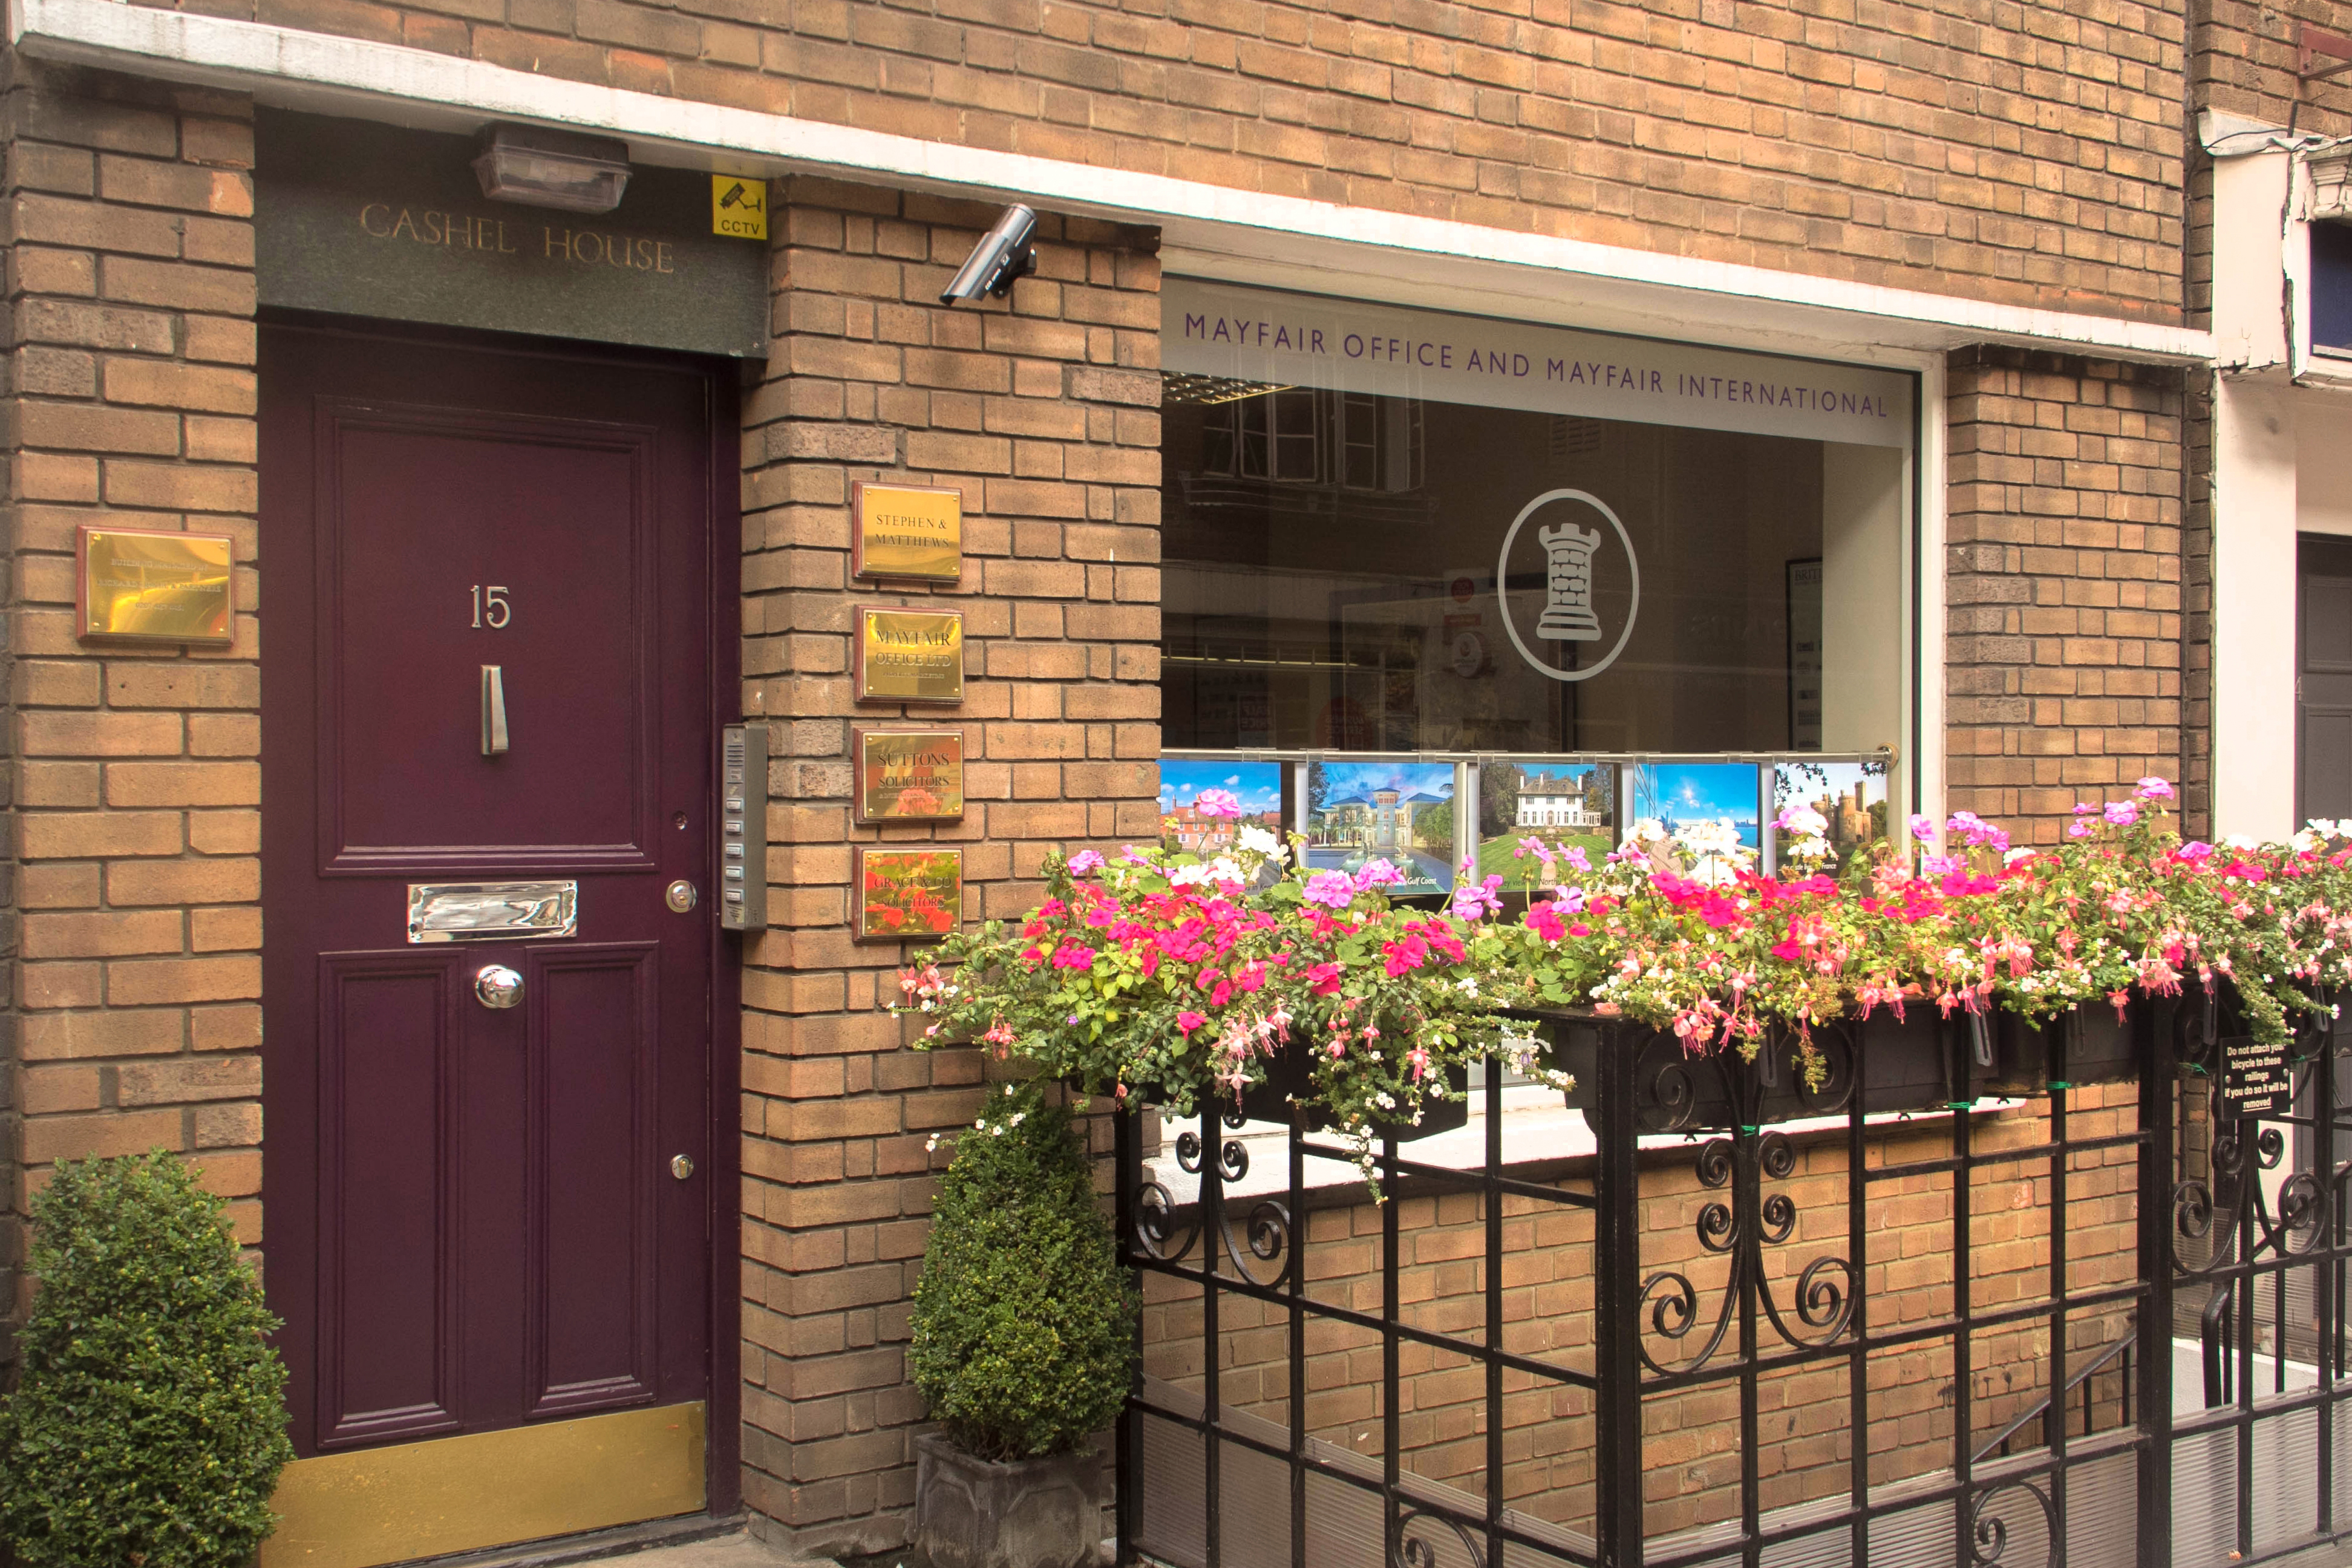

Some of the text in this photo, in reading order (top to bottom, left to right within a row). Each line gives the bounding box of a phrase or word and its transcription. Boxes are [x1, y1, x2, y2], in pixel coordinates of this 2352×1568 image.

[722, 220, 760, 235] CCTV
[360, 203, 674, 273] CASHEL HOUSE
[1186, 312, 1887, 418] MAYFAIR OFFICE AND MAYFAIR INTERNATIONAL
[876, 514, 947, 529] STEPHEN &
[875, 534, 950, 549] MATTHEWS
[470, 585, 511, 629] 15
[875, 630, 952, 646] MAYFAIR
[875, 652, 952, 667] OFFICE LTD
[877, 753, 950, 767] SUTTONS
[878, 776, 950, 788] SOLICITORS
[874, 877, 952, 889] GRACE & CO
[1407, 877, 1420, 886] Gulf
[881, 897, 945, 908] SOLICITORS
[2227, 1047, 2237, 1056] Do
[2238, 1045, 2250, 1055] not
[2250, 1044, 2270, 1054] attach
[2231, 1056, 2282, 1070] bicycle to these
[2244, 1071, 2270, 1082] railings
[2224, 1081, 2288, 1099] if you do so it will be
[2243, 1096, 2272, 1109] removed
